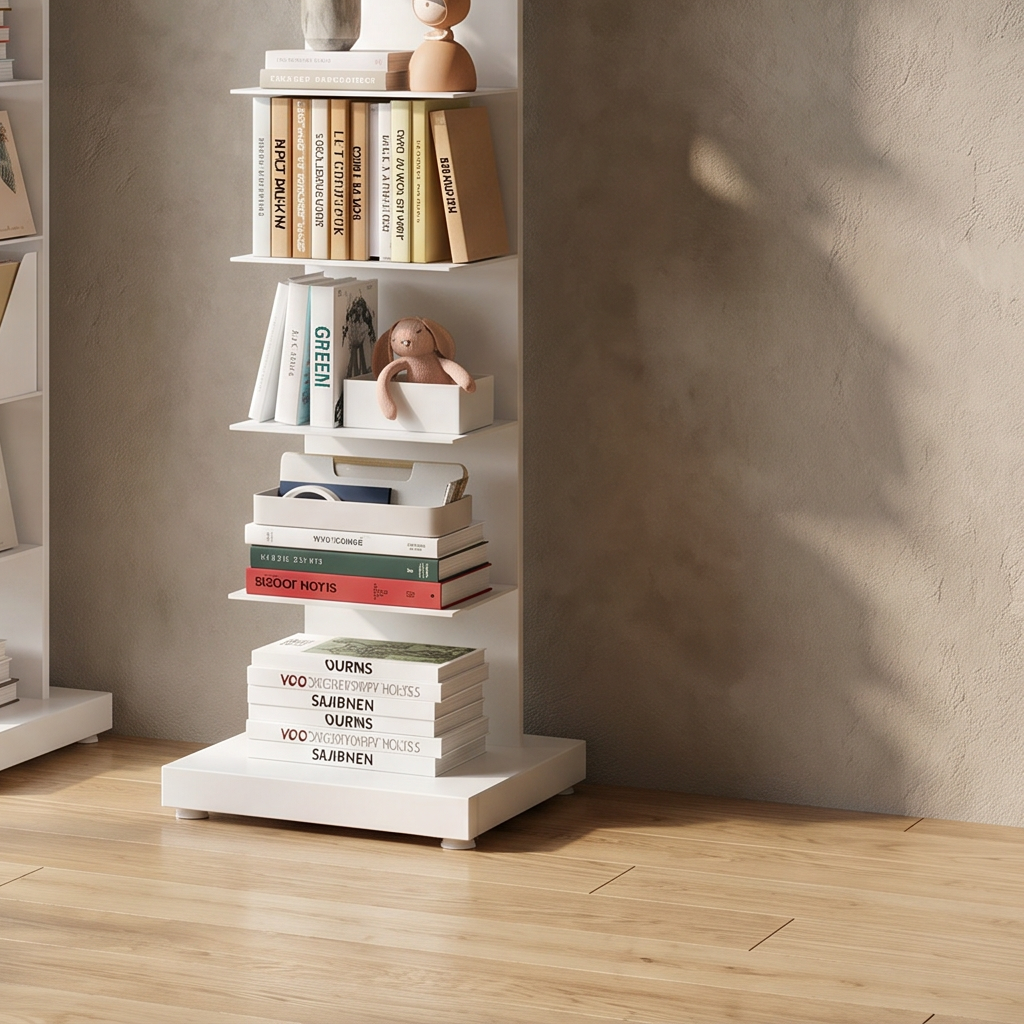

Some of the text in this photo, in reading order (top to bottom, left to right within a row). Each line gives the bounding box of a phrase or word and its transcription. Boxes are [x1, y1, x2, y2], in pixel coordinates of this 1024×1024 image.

[314, 325, 331, 389] GREEN
[325, 659, 373, 675] OURNS
[325, 713, 373, 730] OURNS
